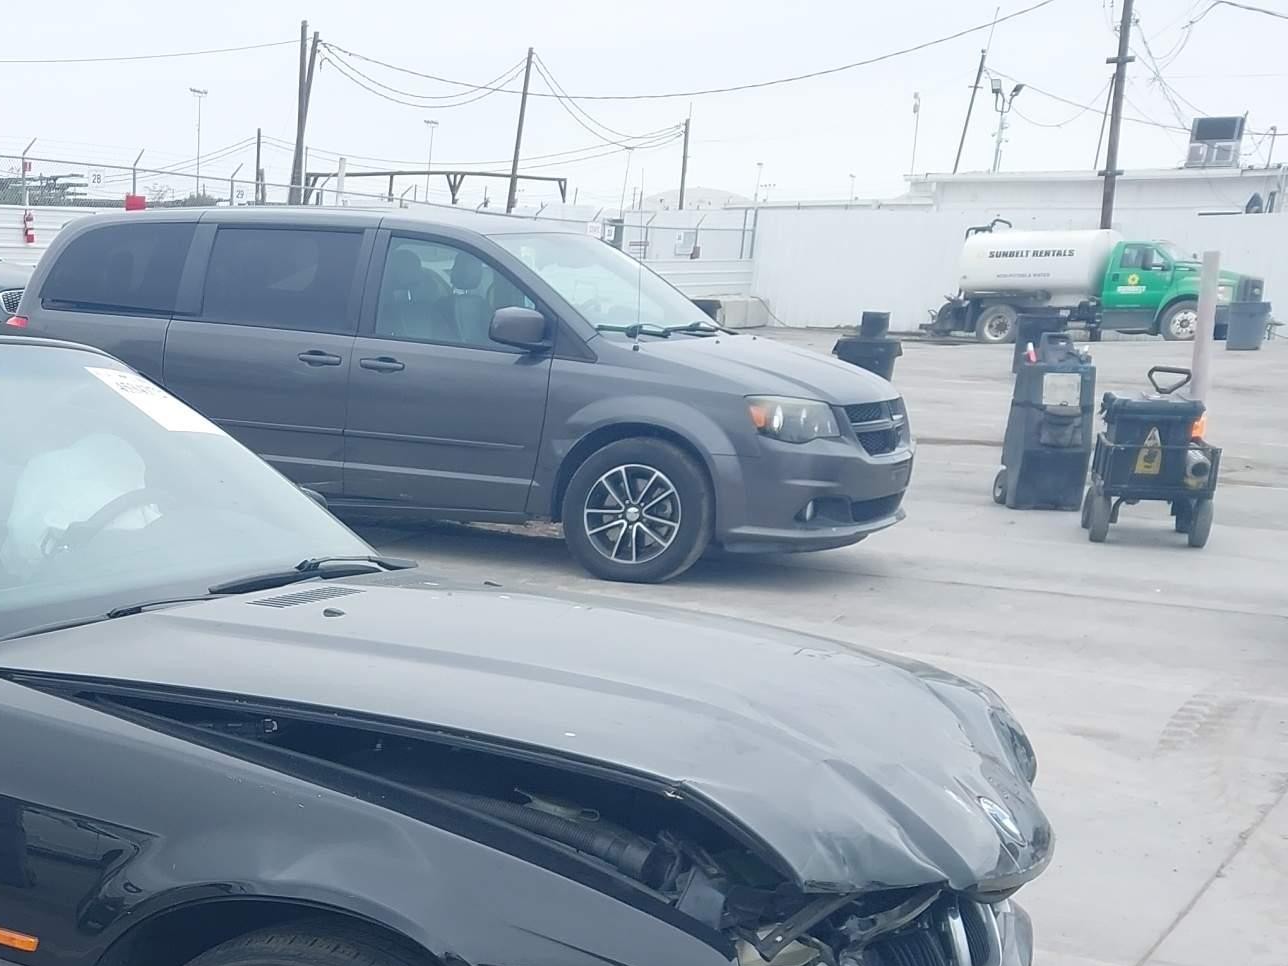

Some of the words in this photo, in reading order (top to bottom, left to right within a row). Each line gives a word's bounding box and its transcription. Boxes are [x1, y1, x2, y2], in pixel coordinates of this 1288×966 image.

[92, 174, 102, 184] 28
[988, 249, 1031, 259] SUNBELT
[1032, 248, 1075, 257] RENTALS
